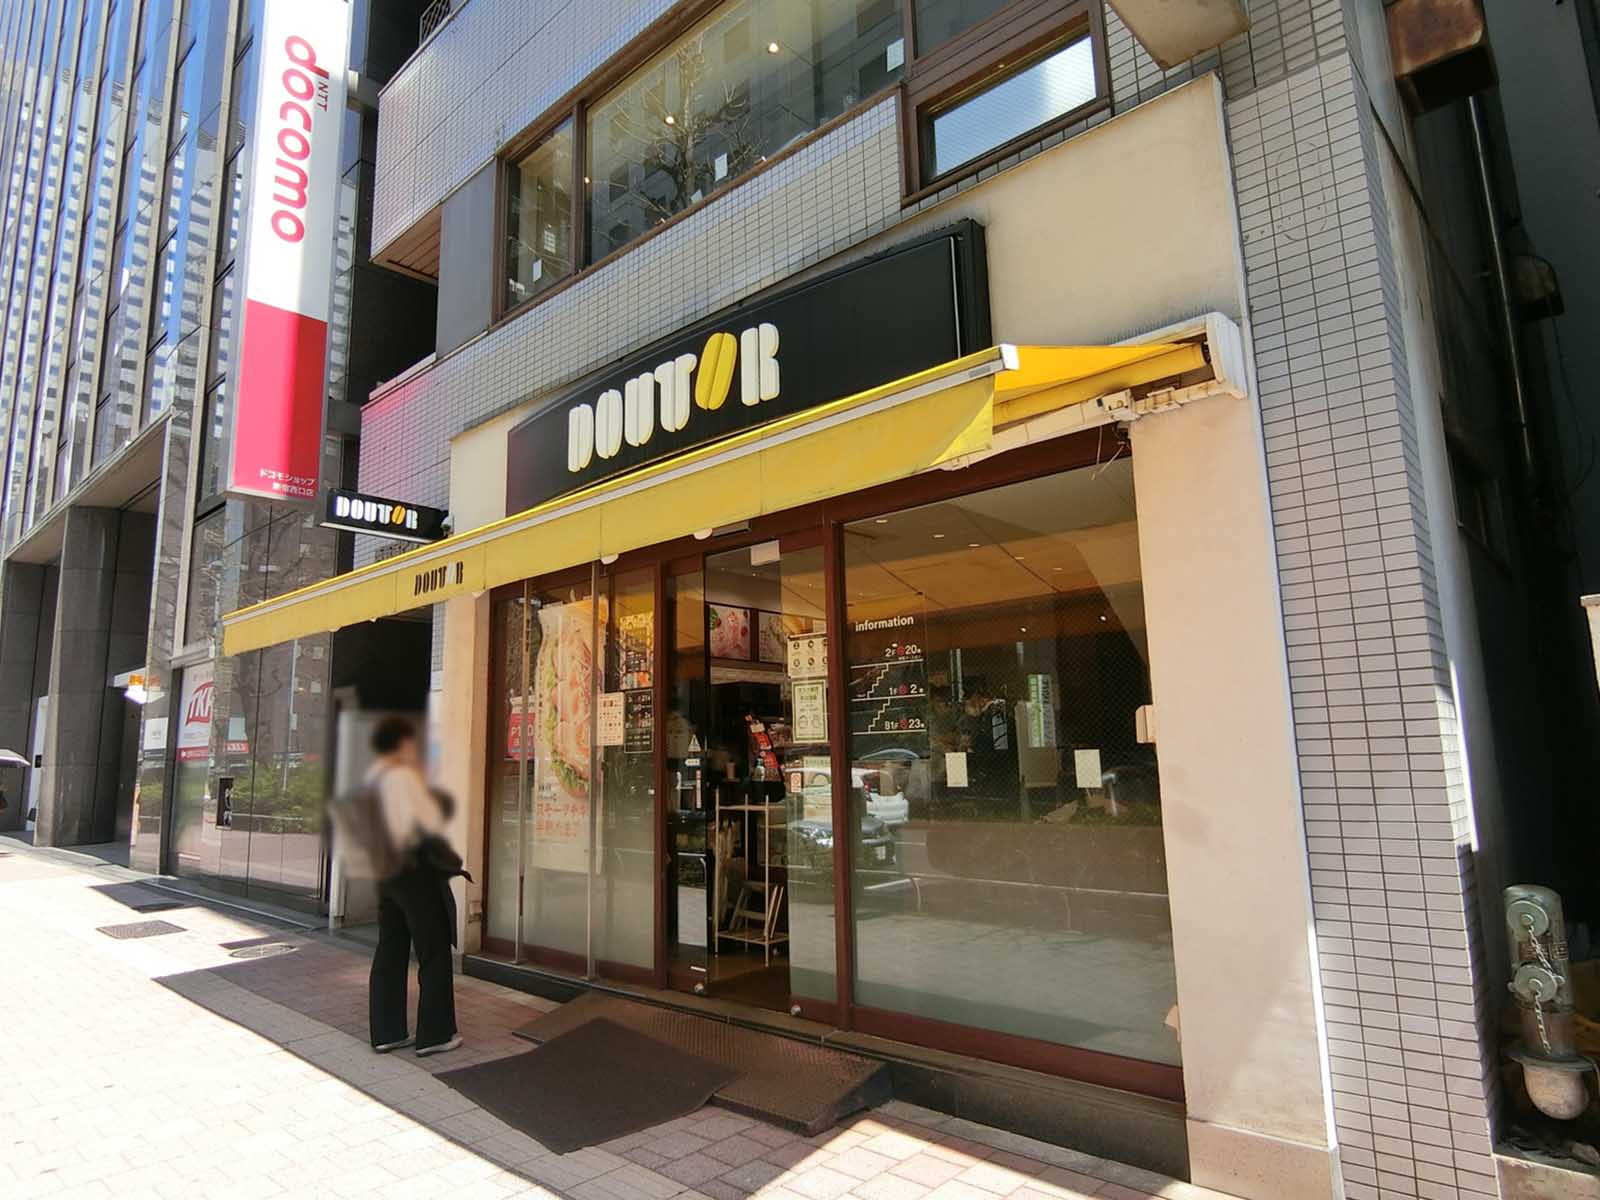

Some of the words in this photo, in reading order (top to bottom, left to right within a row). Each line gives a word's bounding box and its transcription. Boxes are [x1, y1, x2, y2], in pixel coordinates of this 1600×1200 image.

[317, 81, 329, 112] NTT
[271, 35, 330, 243] docomo
[567, 322, 781, 473] DOUTOR
[259, 467, 315, 486] ドコモショップ
[335, 495, 419, 530] DOUTOR
[414, 560, 464, 597] DOUTOR
[855, 615, 915, 633] information
[884, 647, 897, 658] 2F
[889, 687, 898, 696] 1F
